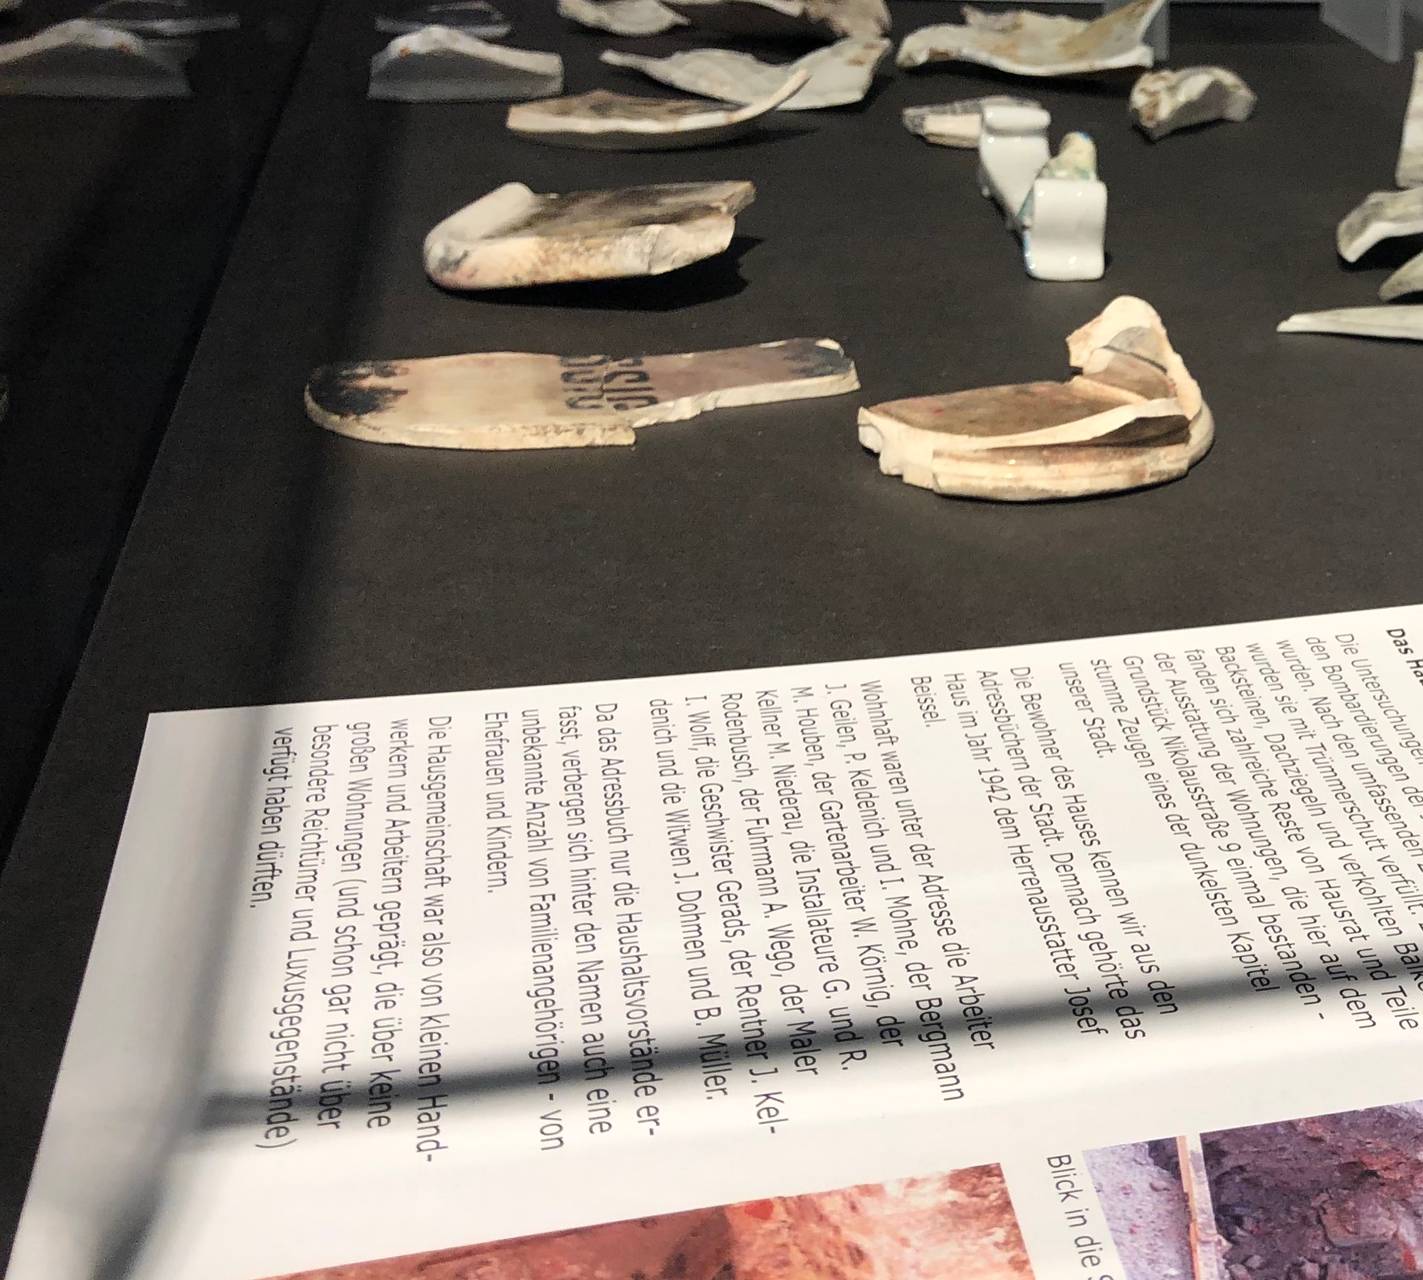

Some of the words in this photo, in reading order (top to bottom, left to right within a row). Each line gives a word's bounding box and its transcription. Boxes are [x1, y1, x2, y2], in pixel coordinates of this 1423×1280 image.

[1334, 633, 1360, 656] Die
[1385, 627, 1415, 656] Das
[594, 702, 619, 723] Da
[790, 686, 815, 704] M.
[824, 683, 848, 695] J.
[859, 679, 900, 748] Wohnhaft
[909, 675, 947, 728] Beissel.
[943, 672, 971, 708] Haus
[1058, 662, 1095, 713] unserer
[1082, 716, 1117, 759] Stadt.
[1122, 655, 1176, 733] Grundstück
[1275, 639, 1316, 693] wurden.
[1308, 696, 1344, 730] Nach
[1331, 733, 1360, 759] den
[1304, 636, 1331, 661] den
[1321, 664, 1411, 783] Bombardierungen
[427, 715, 453, 740] Die
[596, 727, 622, 753] das
[648, 698, 678, 745] denich
[720, 692, 760, 783] Rodenbusch,
[795, 707, 826, 767] Houben,
[829, 698, 858, 748] Geilen,
[956, 710, 979, 729] im
[976, 670, 1031, 772] Adressbüchern
[262, 726, 298, 783] verfügt
[305, 724, 339, 804] besondere
[345, 721, 377, 774] großen
[387, 718, 415, 779] werkern
[484, 711, 510, 787] Ehefrauen
[521, 708, 549, 796] unbekannte
[655, 749, 684, 778] und
[843, 752, 868, 765] P.
[880, 750, 910, 795] waren
[964, 732, 993, 763] Jahr
[385, 783, 412, 813] und
[485, 791, 512, 820] und
[600, 757, 634, 845] Adressbuch
[660, 782, 687, 805] die
[738, 787, 765, 813] der
[811, 771, 837, 796] der
[847, 768, 890, 840] Keldenich
[977, 767, 1012, 804] 1942
[1017, 774, 1043, 799] der
[1160, 735, 1231, 839] Nikolausstraße
[1214, 645, 1271, 730] Backsteinen,
[1263, 732, 1328, 817] Dachziegeln
[1316, 820, 1354, 849] und
[1337, 852, 1404, 938] verkohlten
[260, 786, 292, 836] haben
[335, 777, 373, 873] Wohnungen
[420, 744, 452, 890] Hausgemeinschaft
[525, 800, 555, 853] Anzahl
[894, 798, 925, 839] unter
[992, 807, 1022, 840] dem
[1028, 802, 1065, 848] Stadt.
[1089, 658, 1129, 714] stumme
[1116, 716, 1156, 768] Zeugen
[1143, 771, 1177, 810] eines
[1164, 813, 1193, 838] der
[1179, 842, 1239, 927] dunkelsten
[1226, 931, 1281, 993] Kapitel
[294, 807, 331, 902] Reichtümer
[381, 818, 412, 895] Arbeitern
[486, 825, 514, 894] Kindern.
[664, 808, 692, 867] Witwen
[744, 817, 780, 897] Fuhrmann
[818, 799, 867, 913] Gartenarbeiter
[869, 843, 902, 873] und
[908, 843, 936, 869] der
[1183, 648, 1220, 695] fanden
[1209, 698, 1240, 725] sich
[1225, 727, 1279, 799] zahlreiche
[1267, 801, 1306, 843] Reste
[1295, 845, 1326, 874] von
[1313, 878, 1371, 943] Hausrat
[1356, 947, 1398, 982] und
[1380, 984, 1420, 1031] Teile
[1217, 842, 1242, 853] 9
[249, 840, 286, 909] dürften.
[527, 857, 550, 888] von
[609, 849, 632, 877] nur
[672, 871, 700, 885] J.
[879, 876, 905, 891] I.
[1225, 857, 1276, 909] einmal
[332, 878, 368, 919] (und
[423, 893, 445, 926] war
[612, 881, 640, 908] die
[761, 902, 789, 919] A.
[917, 874, 958, 937] Adresse
[1007, 843, 1080, 981] Herrenausstatter
[1048, 851, 1102, 926] Demnach
[289, 908, 319, 942] und
[369, 900, 407, 976] geprägt,
[421, 931, 452, 968] also
[676, 889, 707, 961] Dohmen
[849, 916, 879, 938] W.
[884, 895, 919, 956] Mohne,
[330, 924, 363, 978] schon
[764, 923, 796, 978] Wego,
[941, 942, 971, 969] die
[1076, 930, 1129, 1001] gehörte
[1256, 913, 1322, 1006] bestanden
[321, 983, 353, 1016] gar
[373, 981, 406, 1011] die
[420, 972, 443, 1008] von
[525, 892, 569, 1085] Familienangehörigen
[687, 966, 721, 1001] und
[778, 983, 809, 1015] der
[856, 943, 895, 1009] Körnig,
[904, 961, 934, 991] der
[615, 911, 664, 1098] Haushaltsvorstände
[693, 1006, 722, 1027] B.
[951, 974, 996, 1050] Arbeiter
[1063, 986, 1110, 1035] Josef
[1114, 1005, 1147, 1040] das
[254, 947, 317, 1149] Luxusgegenstände)
[320, 1022, 356, 1074] nicht
[371, 1016, 404, 1063] über
[410, 1012, 451, 1090] kleinen
[783, 1020, 823, 1076] Maler
[875, 1015, 907, 1048] der
[914, 997, 965, 1102] Bergmann
[697, 1032, 734, 1101] Müller.
[312, 1079, 353, 1130] über
[361, 1068, 402, 1129] keine
[635, 1104, 661, 1136] er-
[412, 1093, 449, 1163] Hand-
[539, 1108, 565, 1151] von
[1047, 1154, 1083, 1203] Blick
[1064, 1208, 1090, 1228] in
[1074, 1235, 1103, 1268] die
